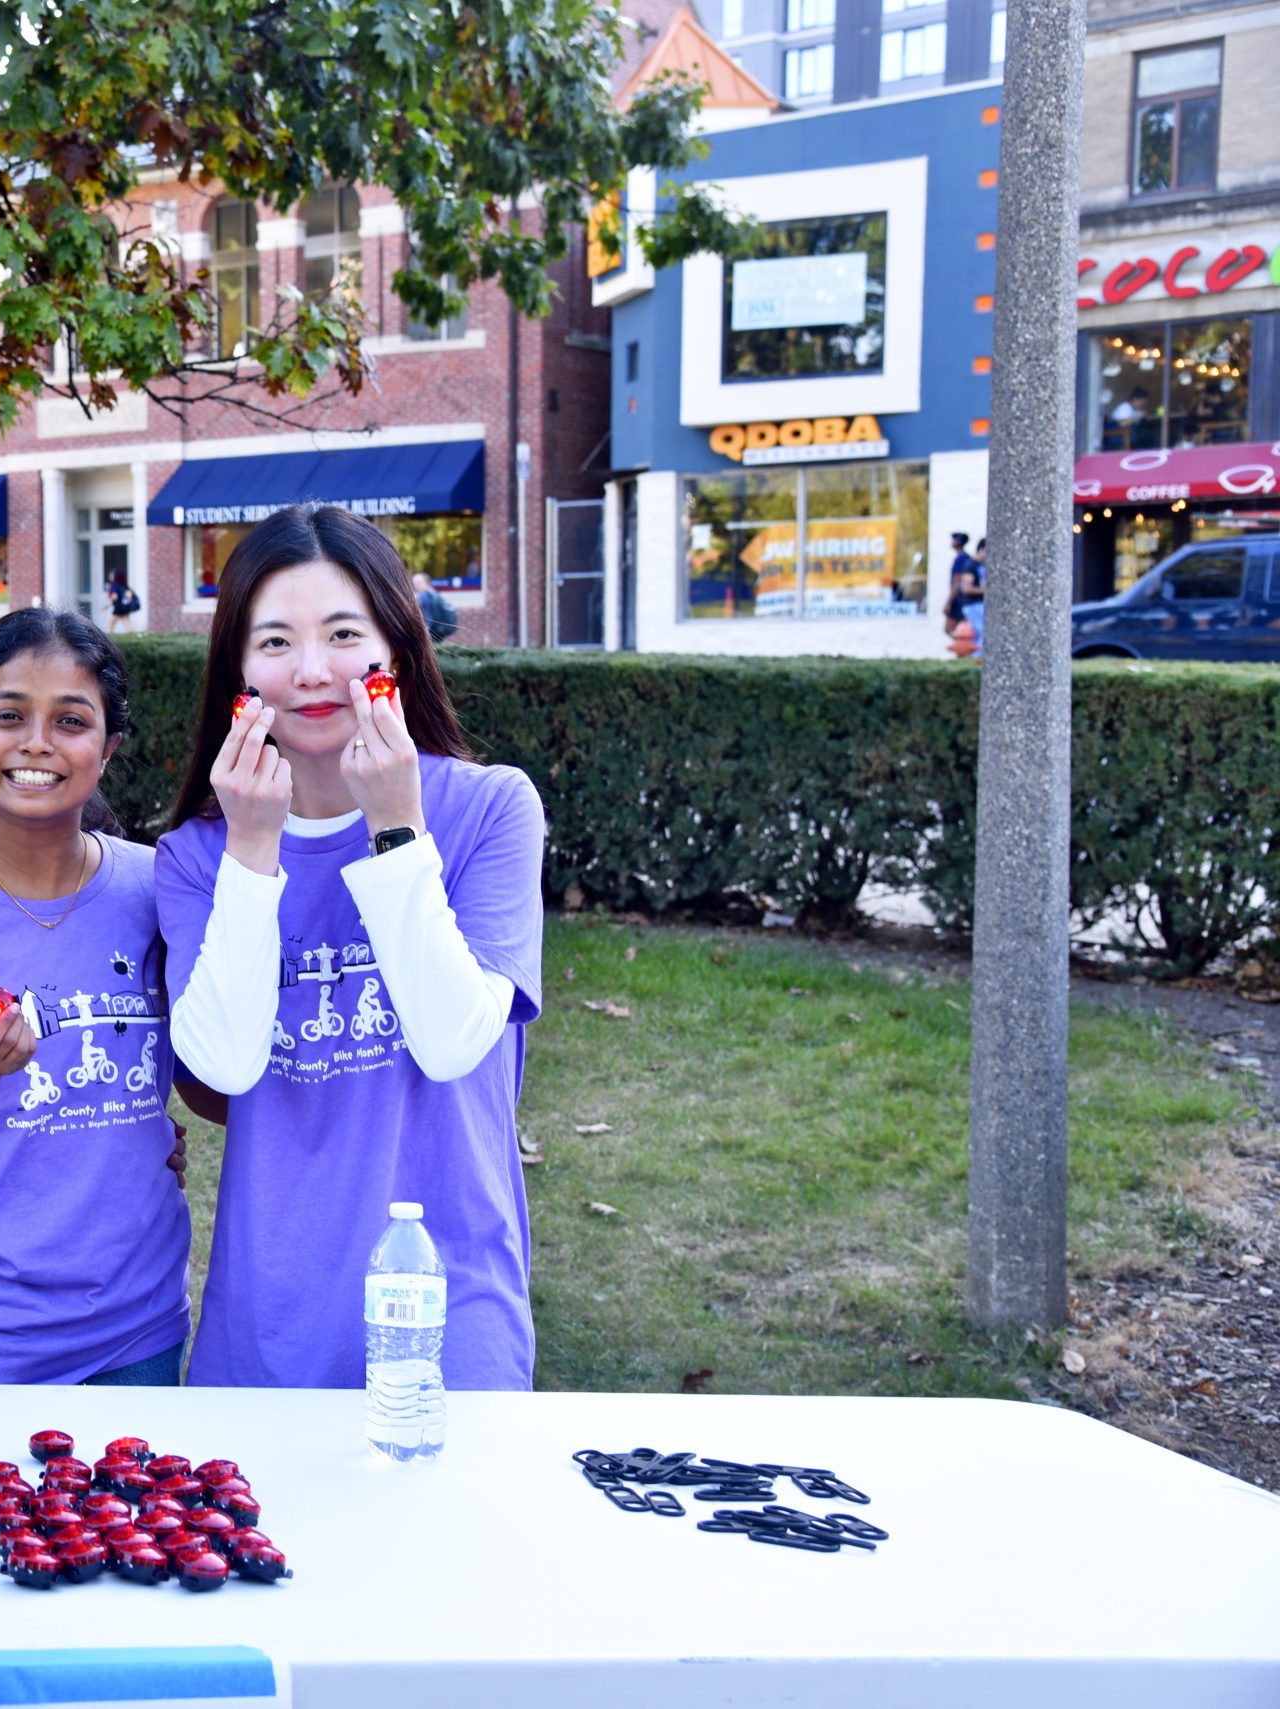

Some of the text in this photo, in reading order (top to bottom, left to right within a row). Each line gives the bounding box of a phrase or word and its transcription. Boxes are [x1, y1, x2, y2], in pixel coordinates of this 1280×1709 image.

[709, 414, 882, 462] QDOBA
[1126, 484, 1190, 501] COFFEE
[185, 507, 242, 524] STUDENT
[351, 496, 415, 516] BUILDING
[295, 1059, 329, 1072] County
[333, 1050, 353, 1063] Bike
[357, 1044, 386, 1058] Month
[6, 1095, 158, 1130] Champaign County Bike Month
